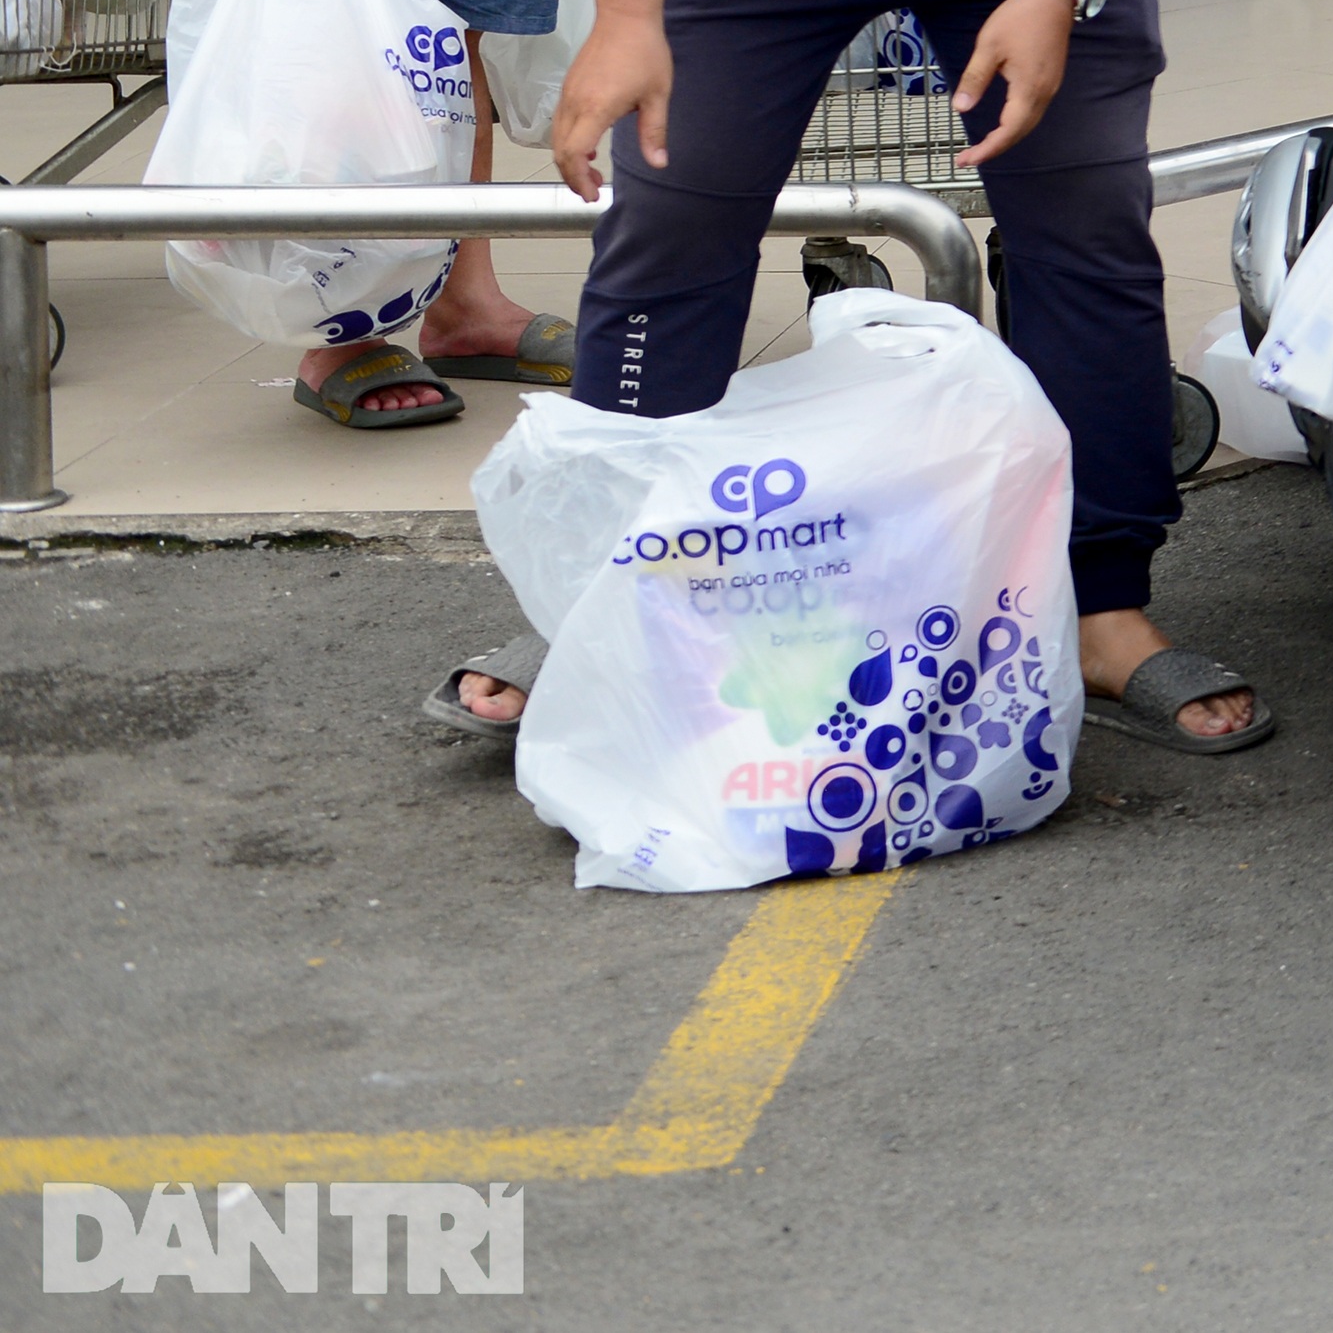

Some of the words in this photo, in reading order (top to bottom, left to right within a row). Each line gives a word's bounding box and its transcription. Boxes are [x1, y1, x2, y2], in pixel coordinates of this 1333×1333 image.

[618, 313, 648, 408] STREET
[688, 576, 726, 593] bạn
[773, 567, 808, 586] mọi
